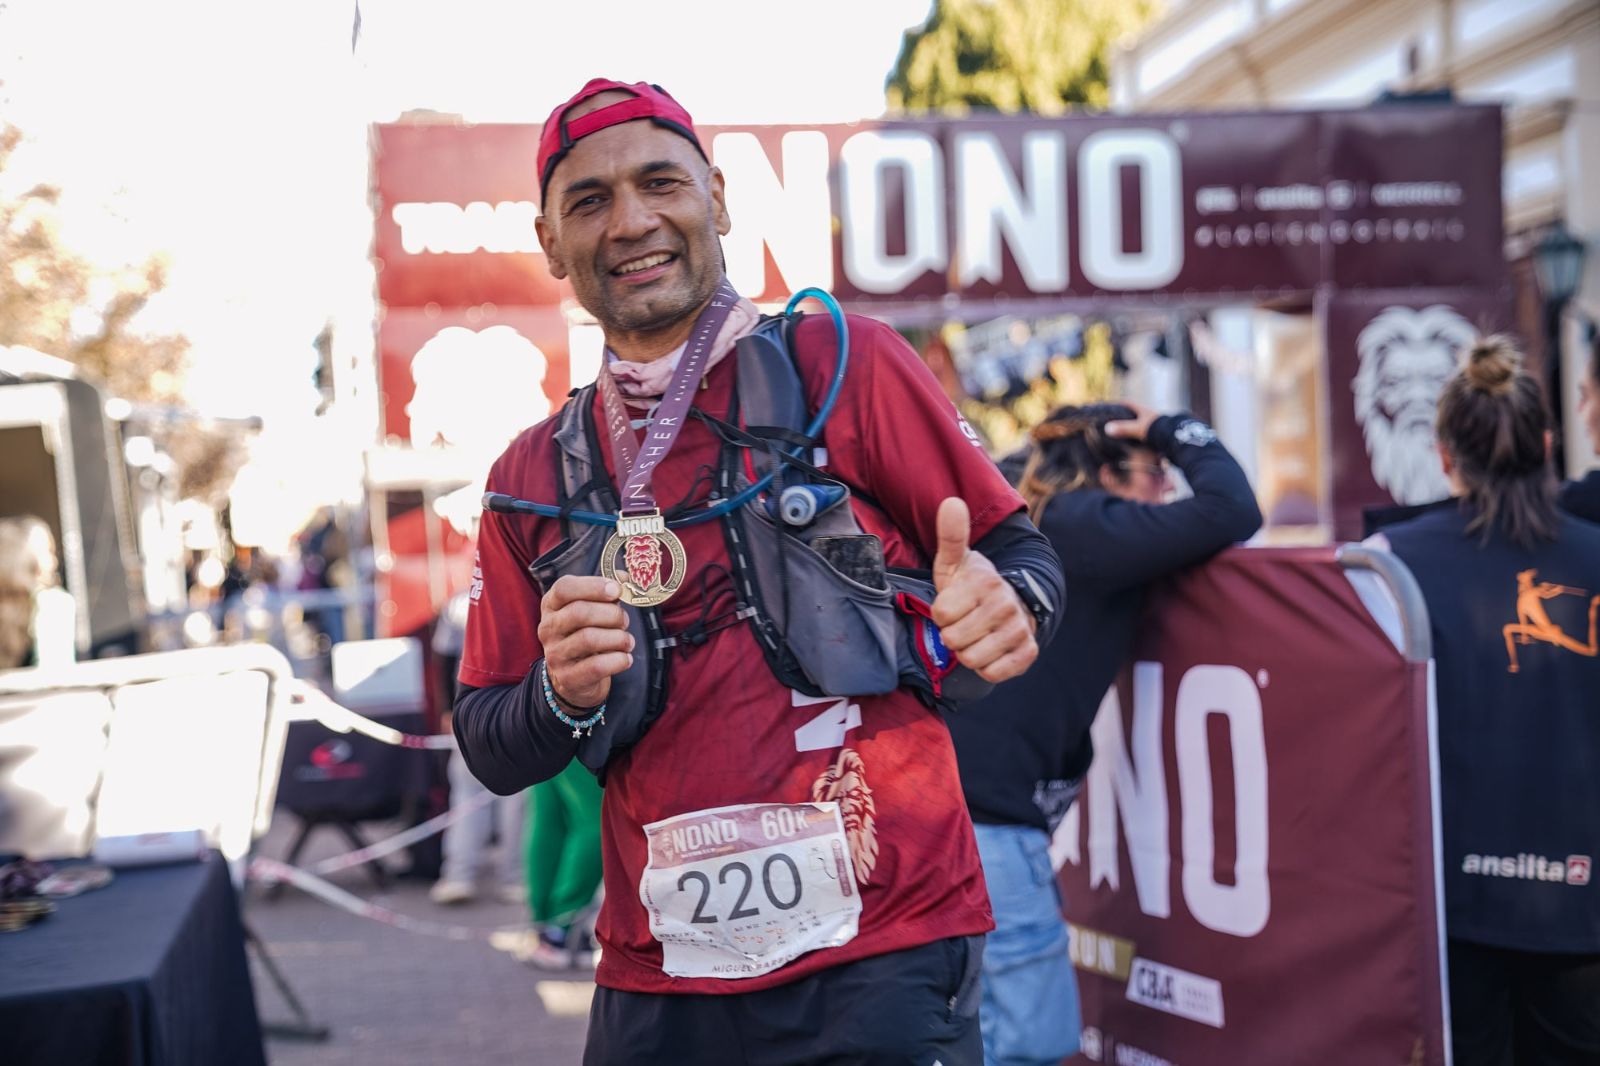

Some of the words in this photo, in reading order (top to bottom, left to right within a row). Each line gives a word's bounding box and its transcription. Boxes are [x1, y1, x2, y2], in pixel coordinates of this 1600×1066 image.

[712, 128, 1185, 299] NONO
[629, 416, 679, 506] INISHER
[616, 516, 664, 537] NONO
[1050, 660, 1270, 938] NO
[671, 819, 739, 854] NONO
[1462, 853, 1565, 882] ansilta
[677, 853, 803, 924] 220
